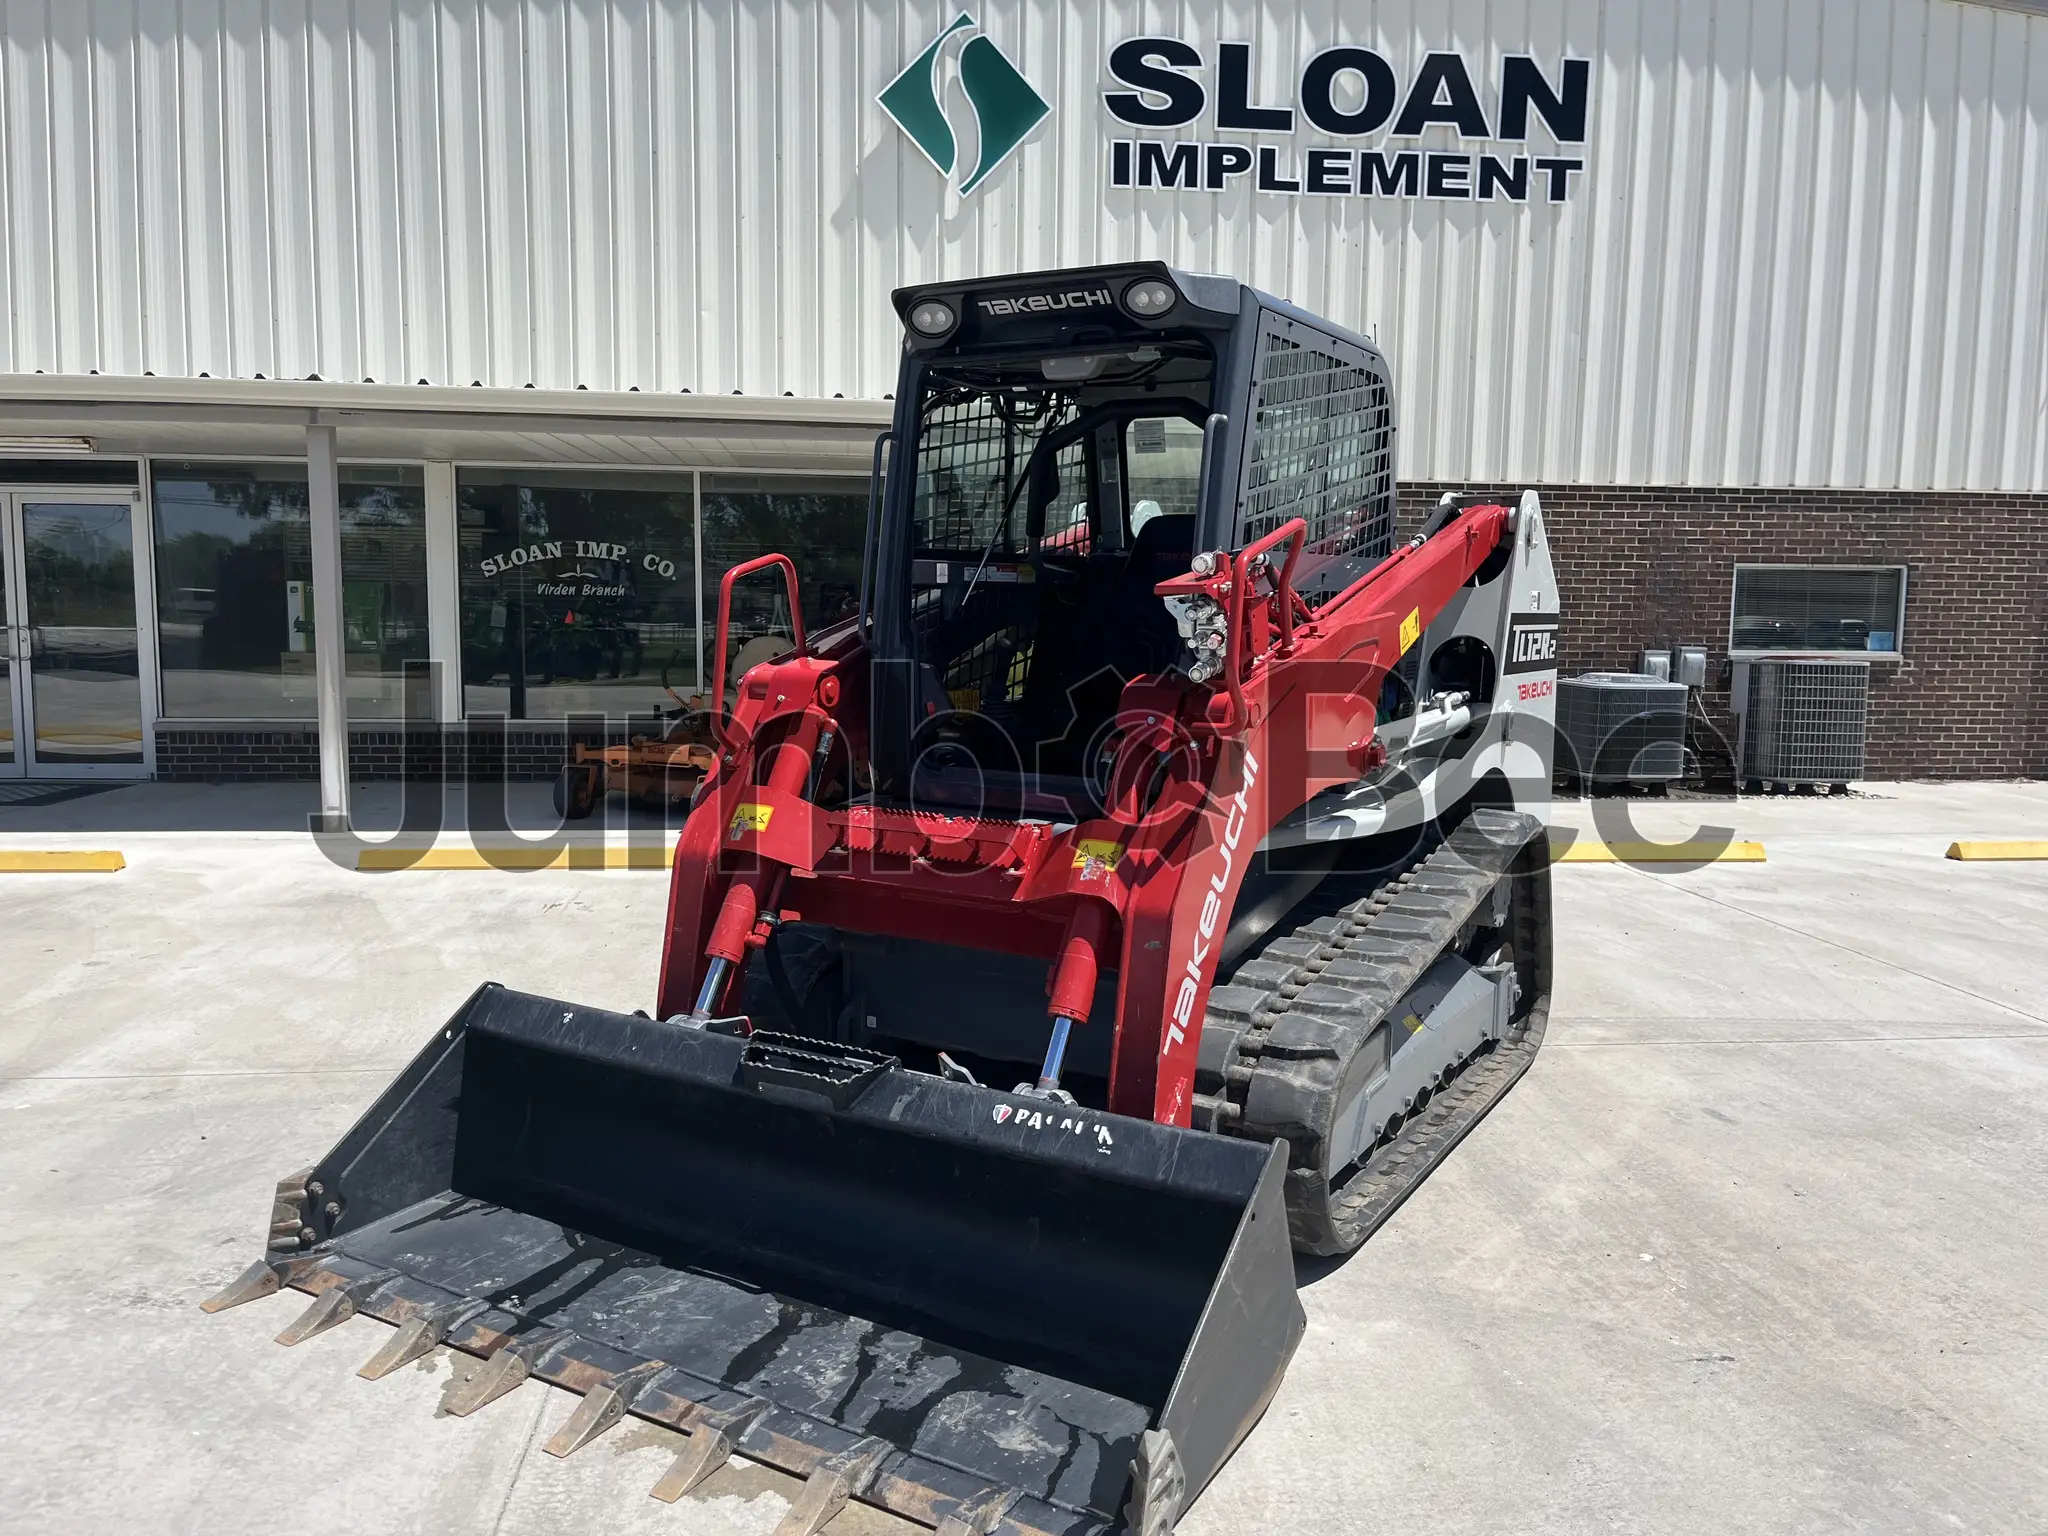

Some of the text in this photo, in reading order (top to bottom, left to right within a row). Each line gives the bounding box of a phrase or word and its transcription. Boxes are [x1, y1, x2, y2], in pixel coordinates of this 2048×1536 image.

[1101, 35, 1593, 146] SLOAN
[1109, 139, 1584, 204] IMPLEMENT
[977, 289, 1113, 316] TAKEUCHI
[480, 540, 677, 581] SLOAN IMP. CO.
[536, 583, 626, 597] Virden Branch
[1512, 624, 1559, 663] TL12R2
[1517, 681, 1553, 702] TAKEUCHI
[1163, 750, 1259, 1056] TAKEUCHI
